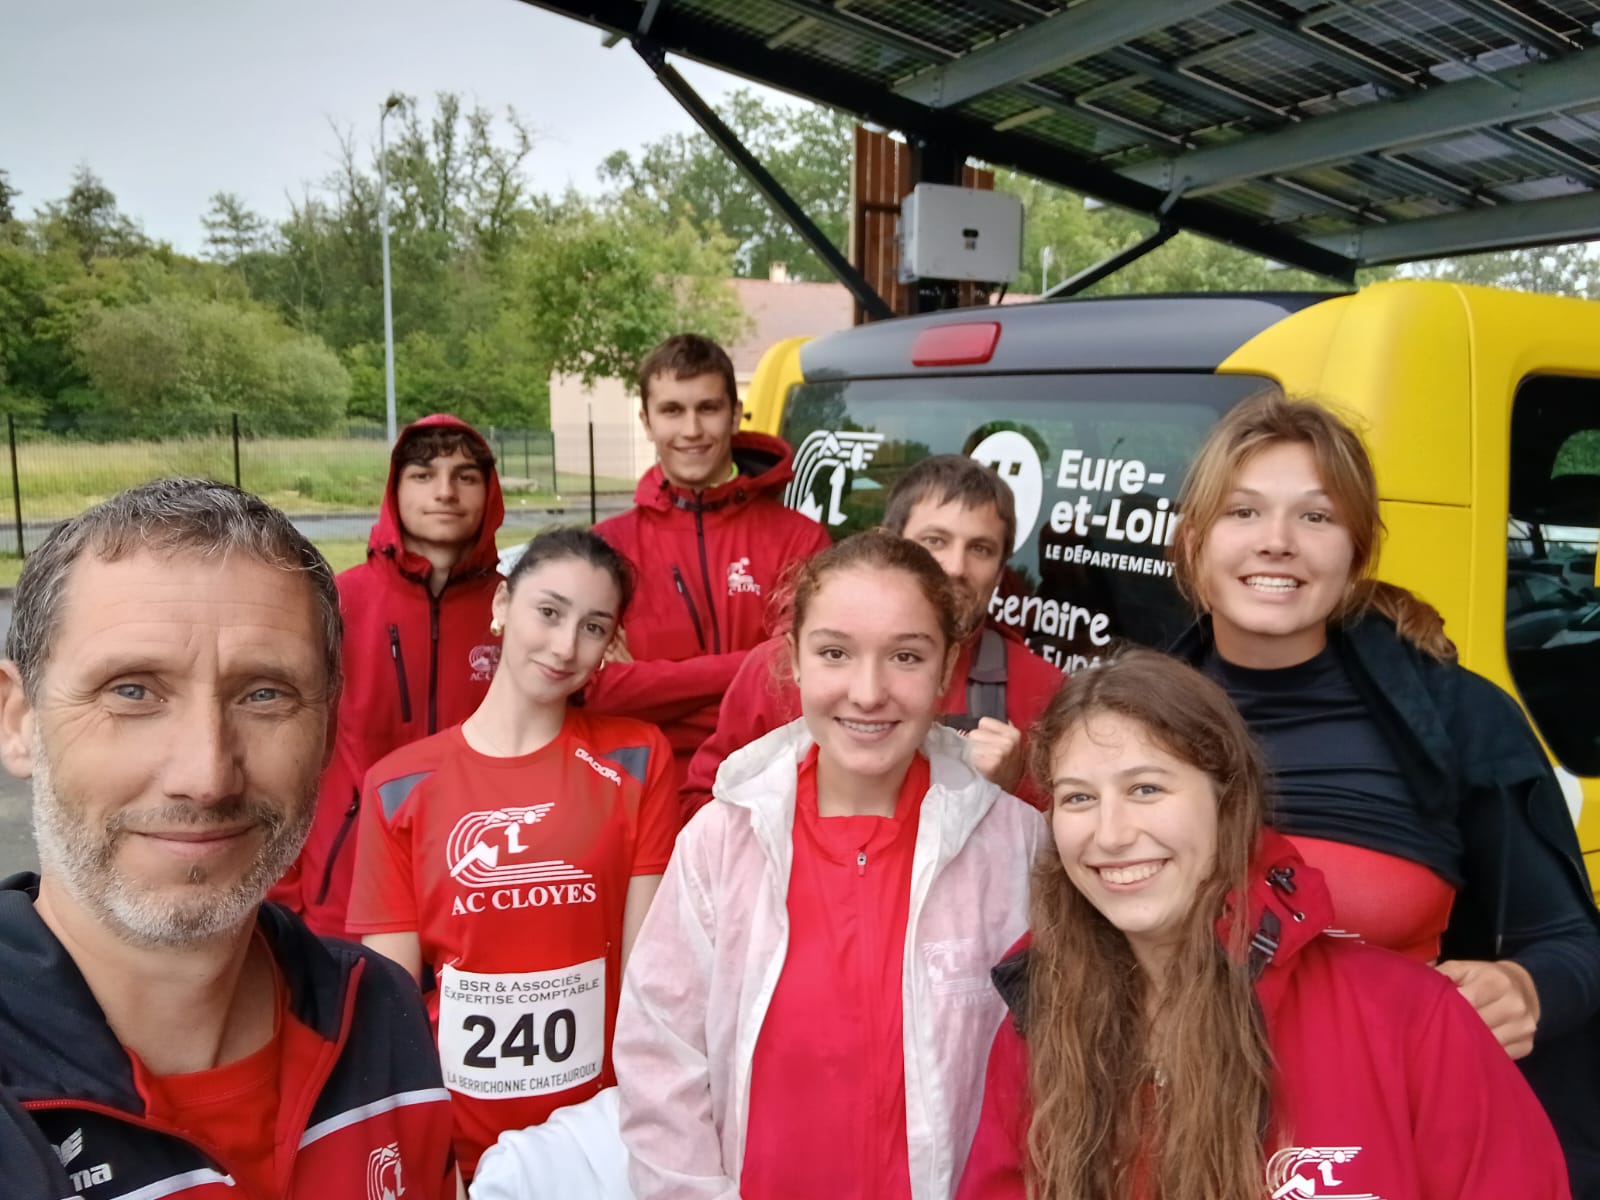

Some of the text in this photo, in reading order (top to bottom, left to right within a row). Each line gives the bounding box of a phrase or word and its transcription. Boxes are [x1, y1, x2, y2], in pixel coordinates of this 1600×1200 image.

[1057, 449, 1166, 494] Eure-
[1050, 496, 1184, 546] et-Loir
[1045, 544, 1176, 577] LE DÉPARTEMENT
[575, 748, 621, 786] DIADORA
[451, 883, 597, 916] AC CLOYES
[445, 978, 600, 1005] EXPERTISE COMPTABLE
[459, 979, 490, 993] BSR
[495, 981, 506, 993] &
[462, 1008, 576, 1069] 240
[447, 1062, 598, 1094] LA BERRICHONNE CHATEAUROUX
